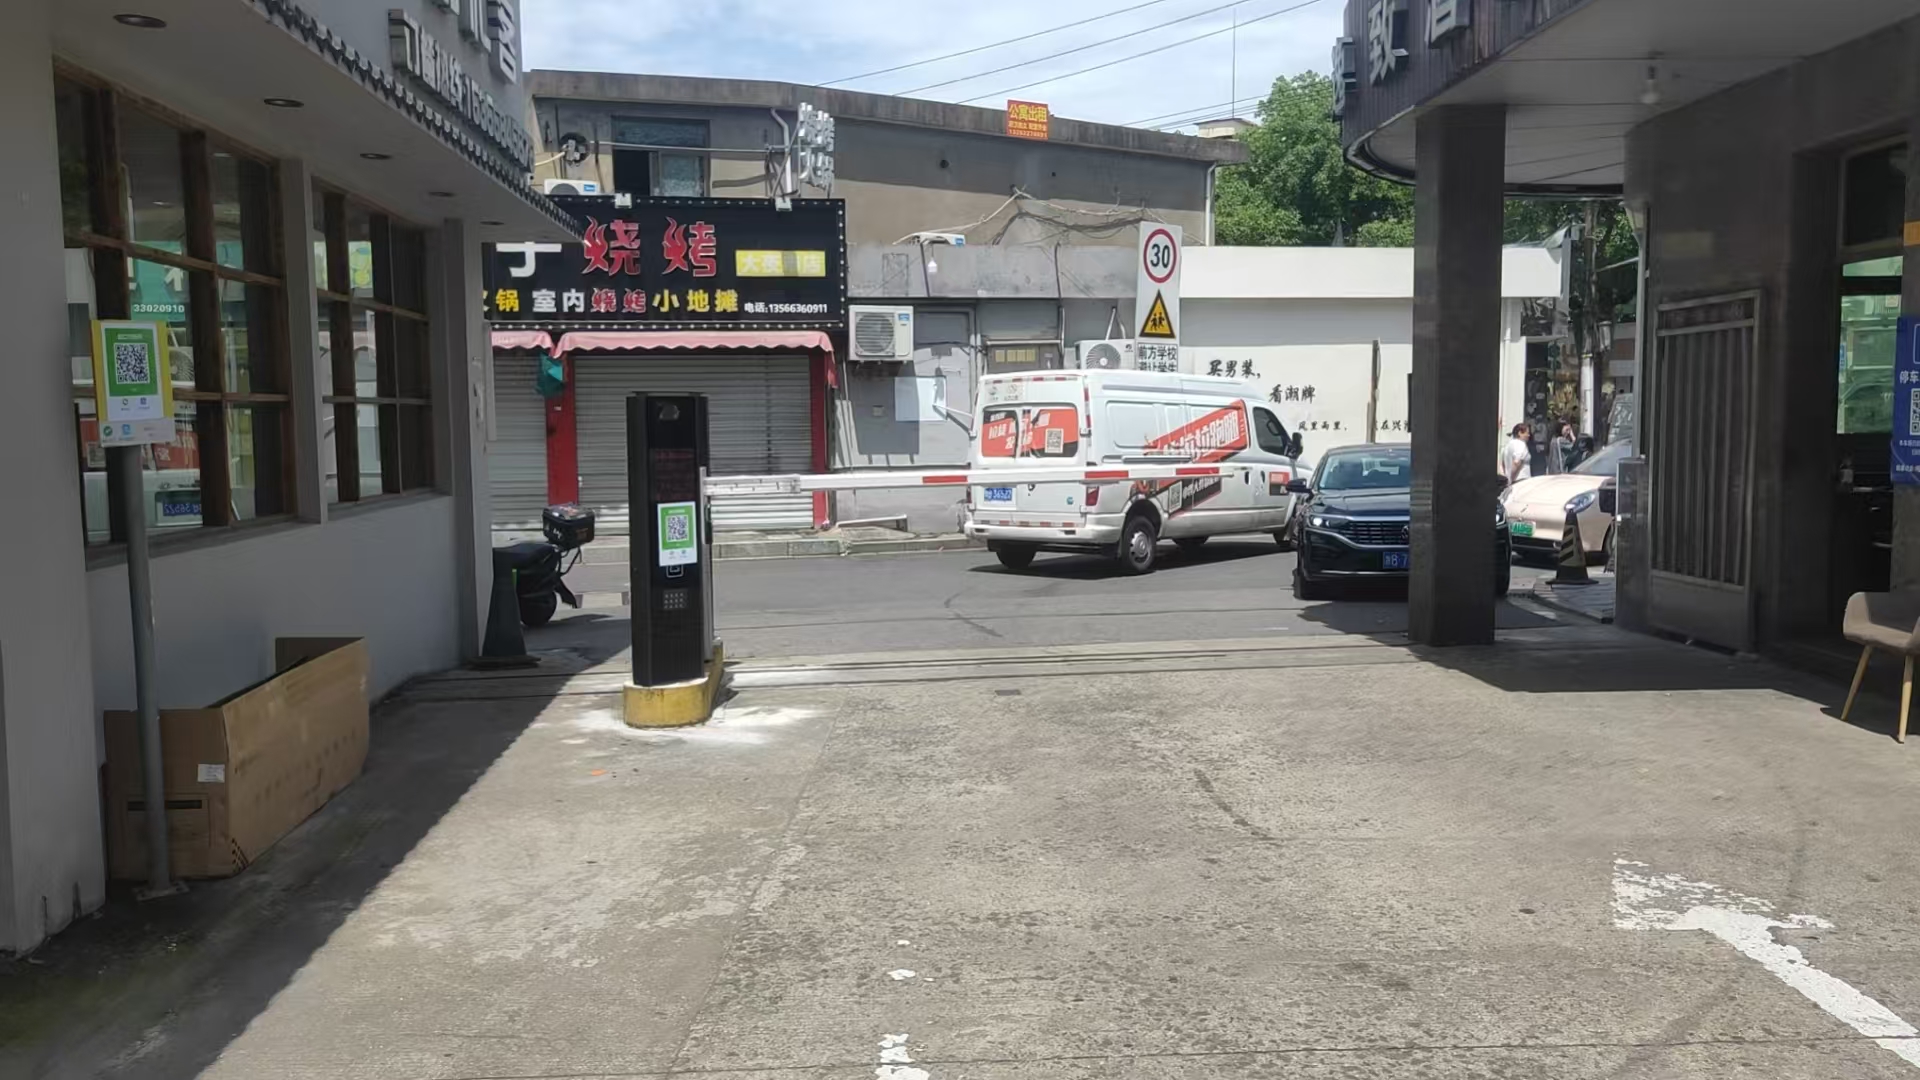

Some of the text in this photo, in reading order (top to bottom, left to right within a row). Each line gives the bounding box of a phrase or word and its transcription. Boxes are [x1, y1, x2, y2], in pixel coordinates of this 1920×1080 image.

[1008, 104, 1048, 122] 公寓出租
[1150, 244, 1171, 269] 30
[1138, 345, 1177, 360] 前方学校
[1268, 384, 1315, 404] 看潮牌
